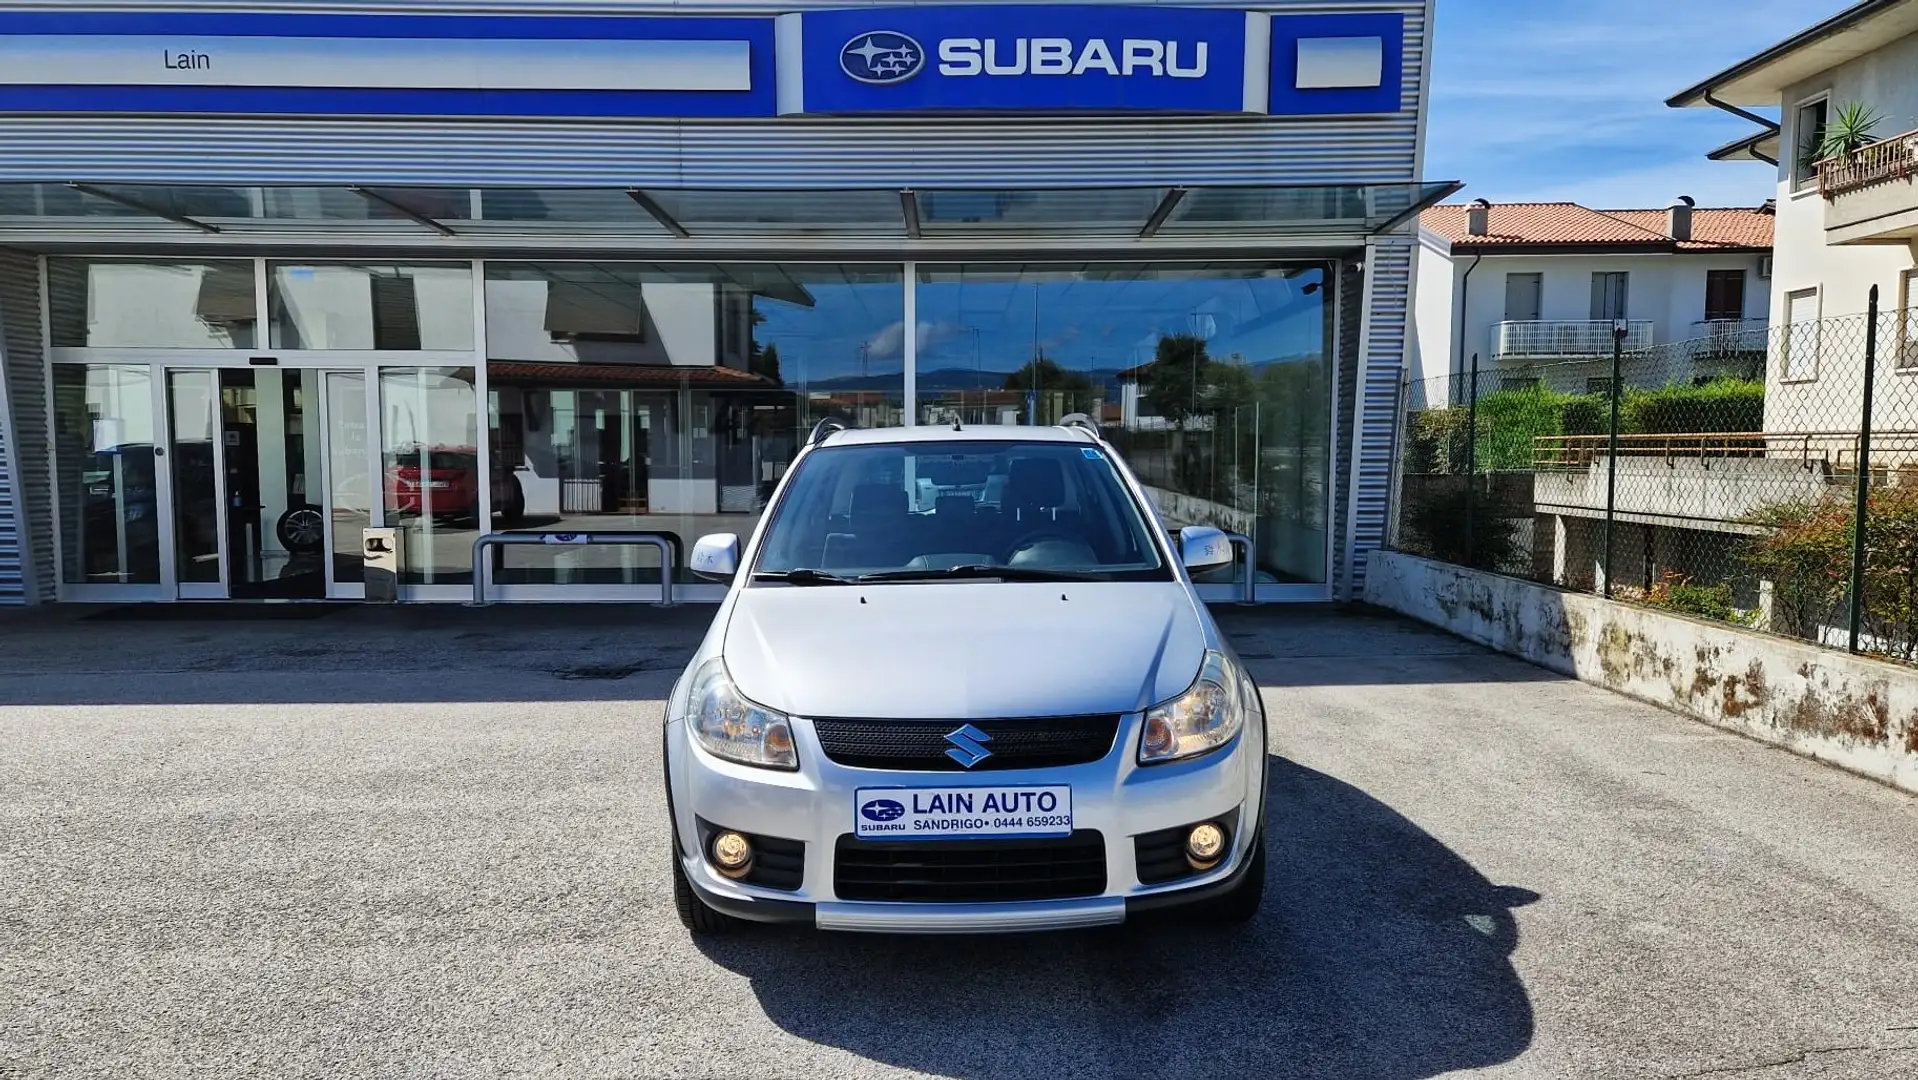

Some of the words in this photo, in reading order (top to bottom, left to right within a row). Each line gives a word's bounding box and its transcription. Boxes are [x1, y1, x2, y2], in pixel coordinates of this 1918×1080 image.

[164, 49, 210, 69] Lain
[938, 37, 1208, 78] SUBARU
[912, 792, 973, 814] LAIN
[982, 791, 1057, 813] AUTO
[861, 823, 906, 831] SUBARU
[993, 817, 1023, 828] 0444
[1026, 815, 1071, 827] 659233
